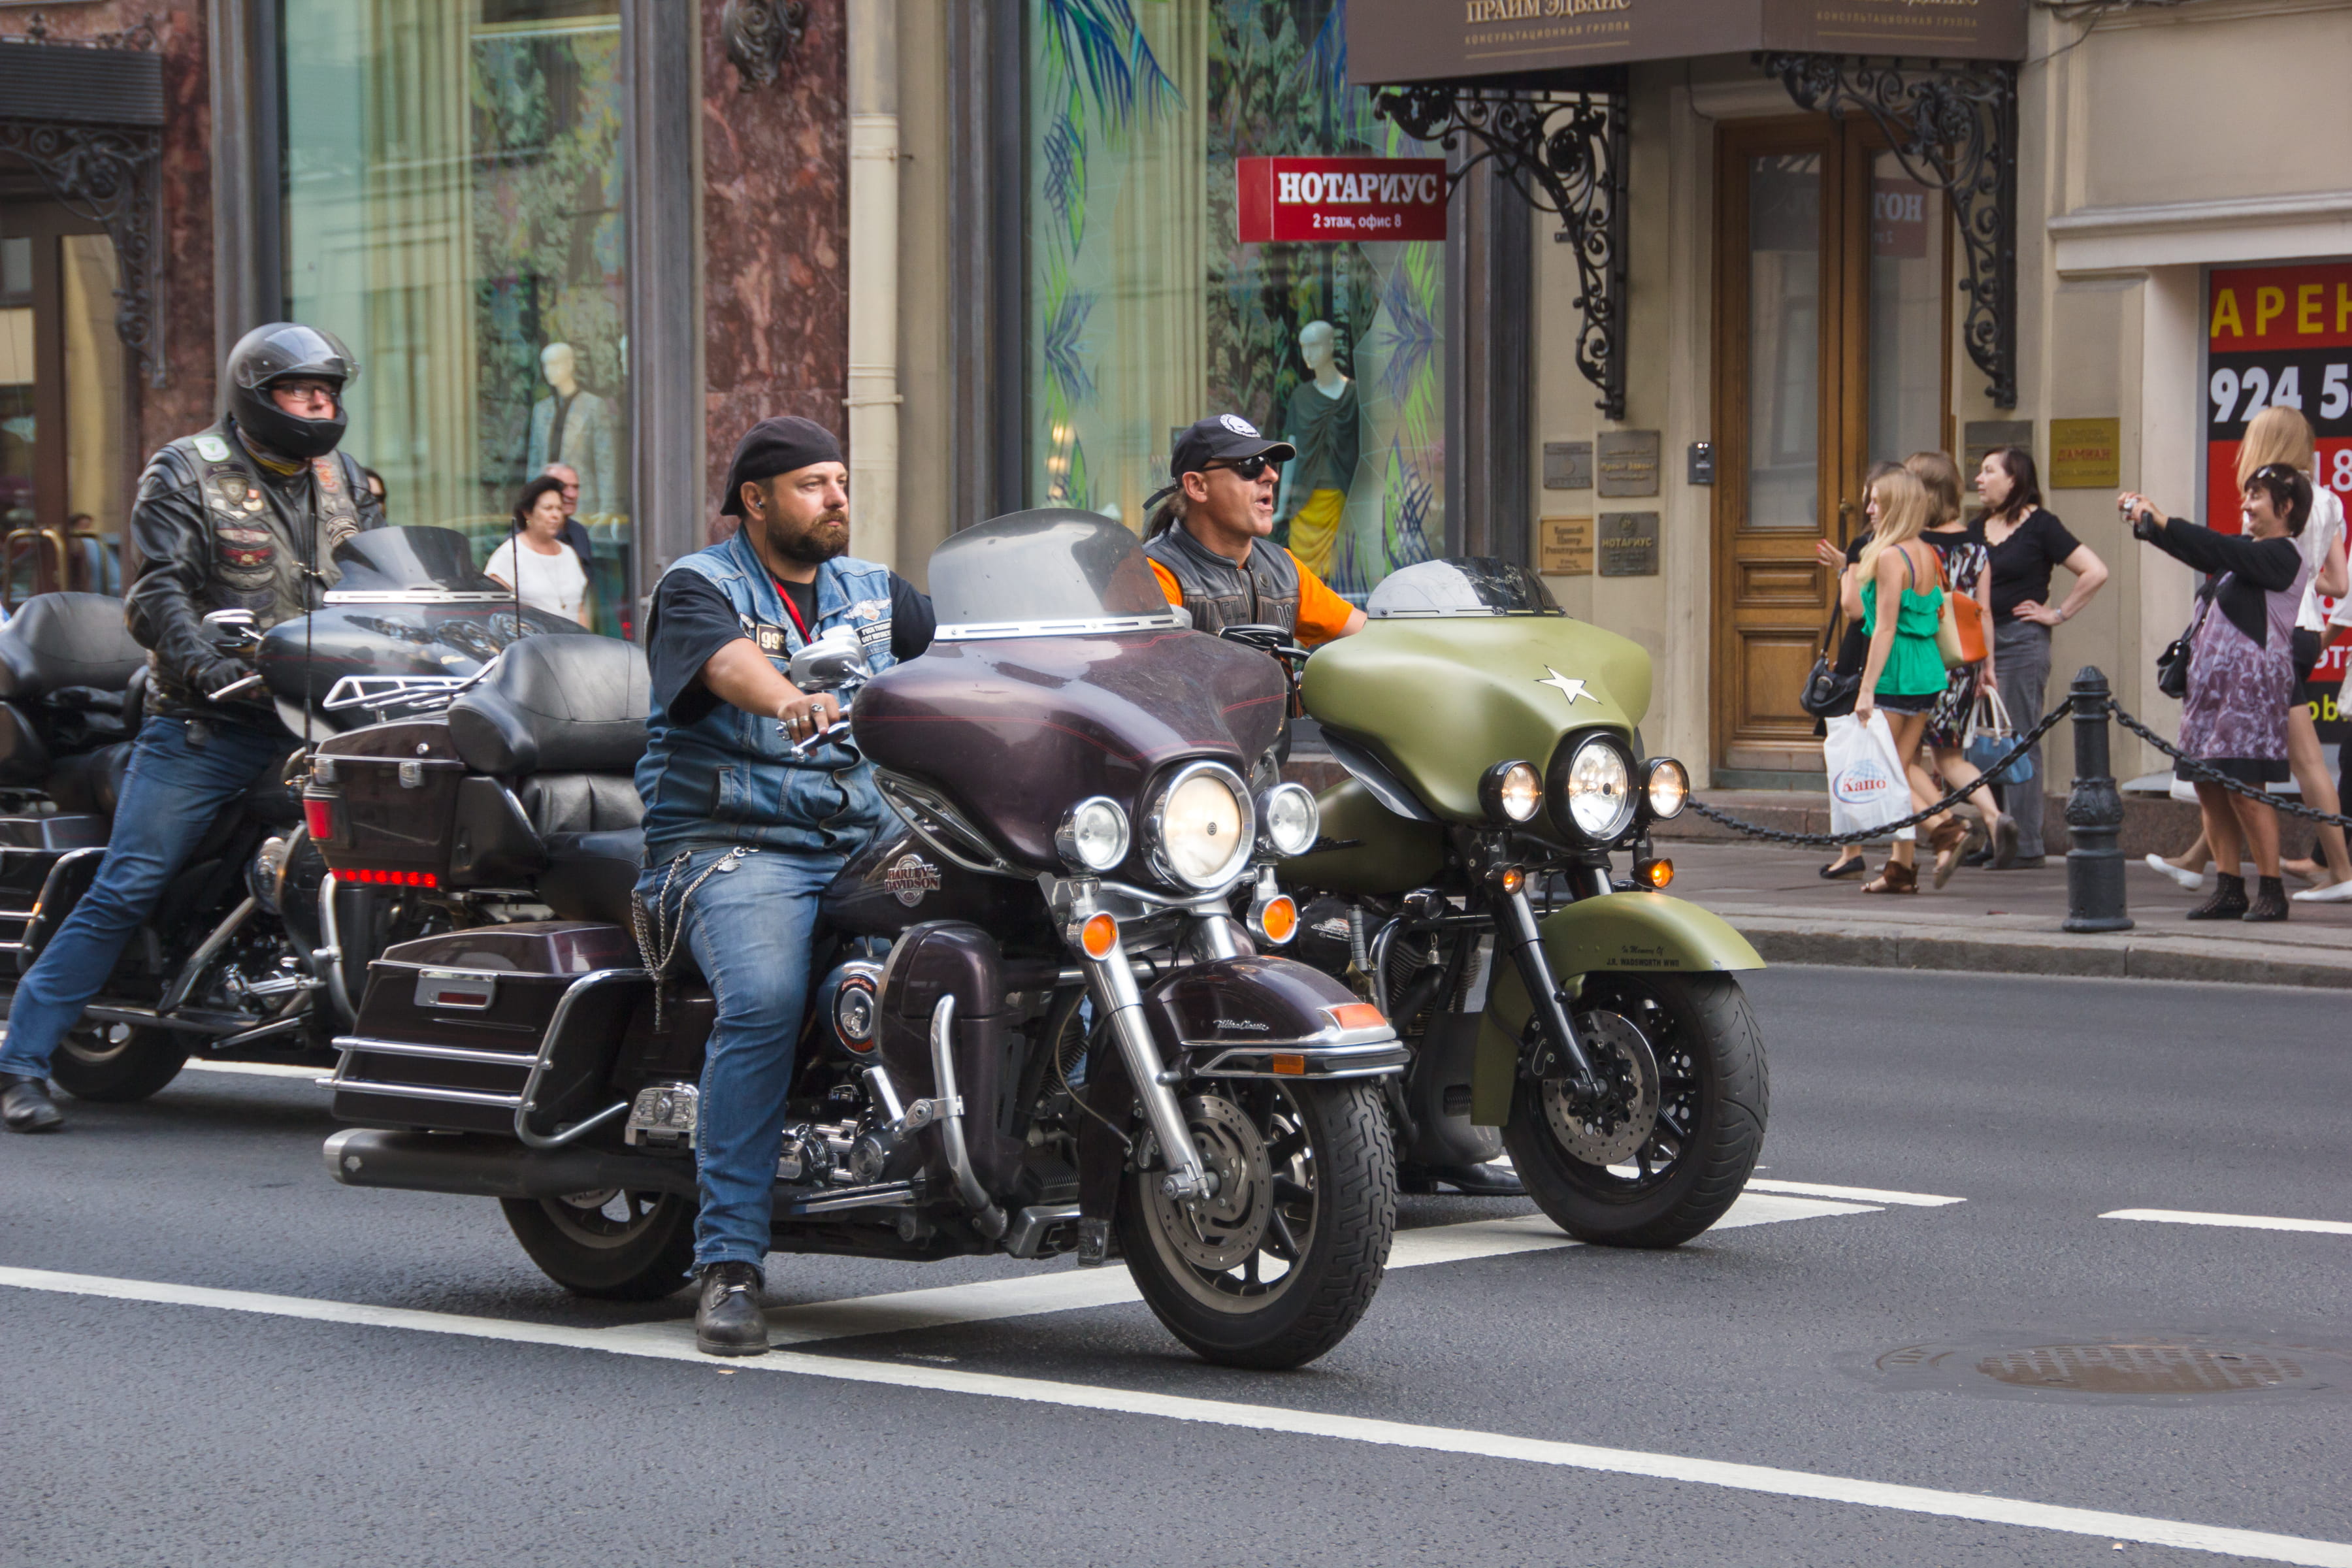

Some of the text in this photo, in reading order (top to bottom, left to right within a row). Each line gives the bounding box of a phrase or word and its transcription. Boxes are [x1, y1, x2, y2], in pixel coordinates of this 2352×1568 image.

[1586, 20, 1630, 33] ГРУППА
[1278, 172, 1437, 204] НОТАРИУС
[1313, 213, 1402, 231] 2 этаж, офис 8
[2210, 363, 2352, 423] 924 5
[1602, 537, 1652, 547] НОТАРИУС
[885, 877, 939, 892] DAVIDSON
[1620, 958, 1661, 967] WADSWORTH
